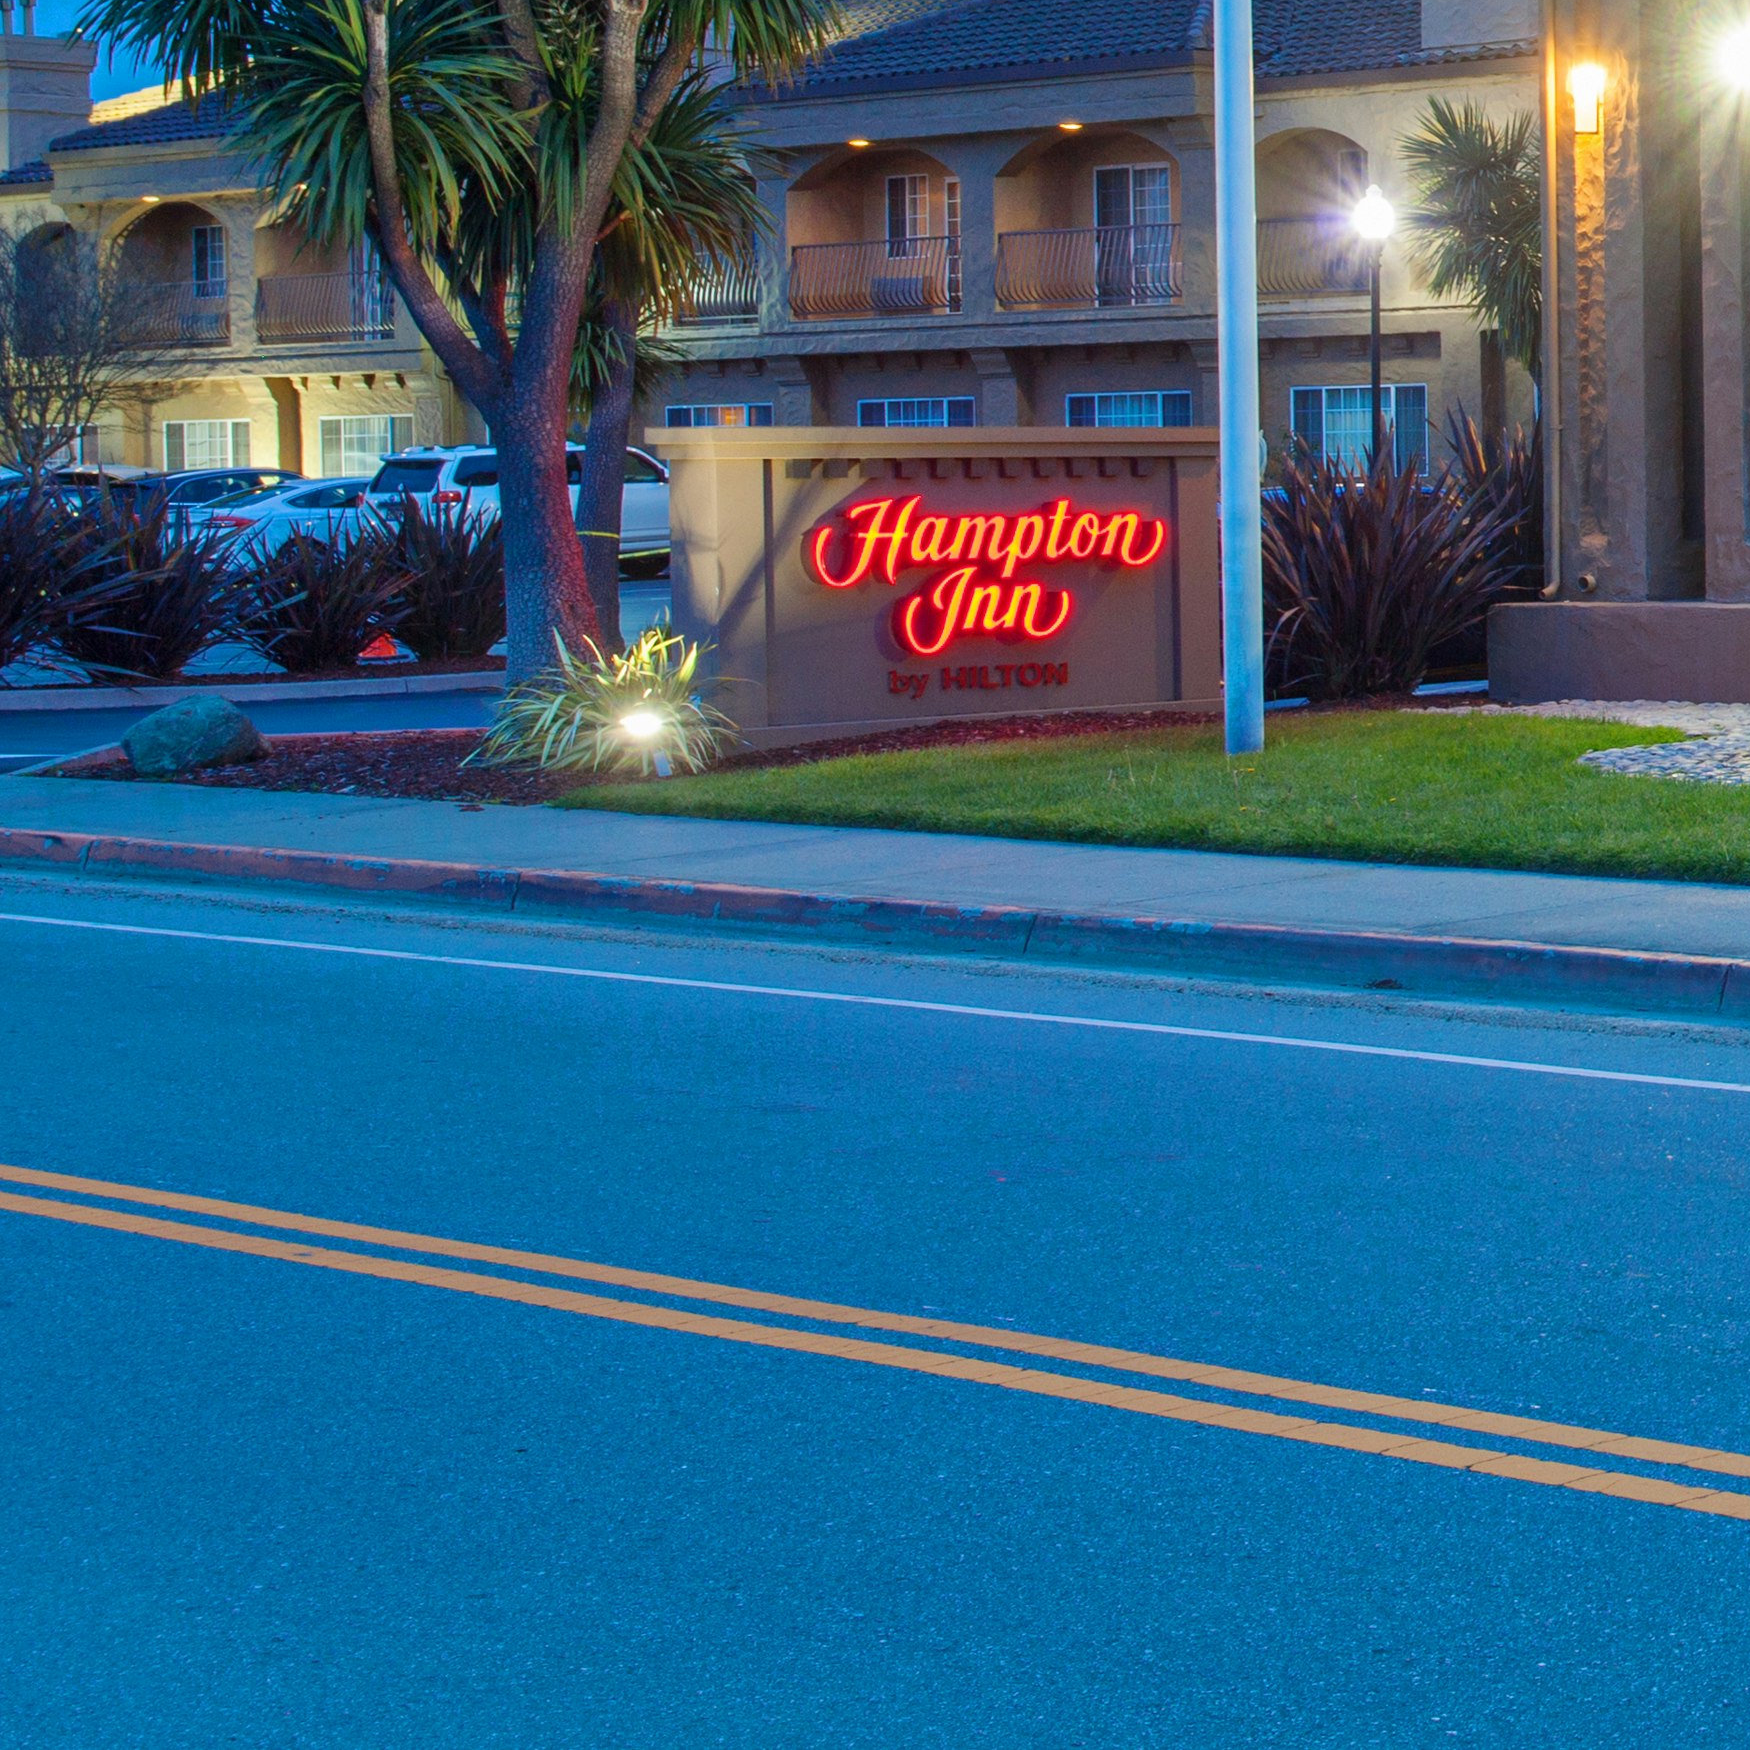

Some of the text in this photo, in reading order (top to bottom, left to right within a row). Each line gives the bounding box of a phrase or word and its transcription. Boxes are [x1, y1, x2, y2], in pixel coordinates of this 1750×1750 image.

[814, 494, 1165, 587] Hampton
[905, 565, 1069, 654] Inn
[888, 661, 1069, 699] by HILTON
